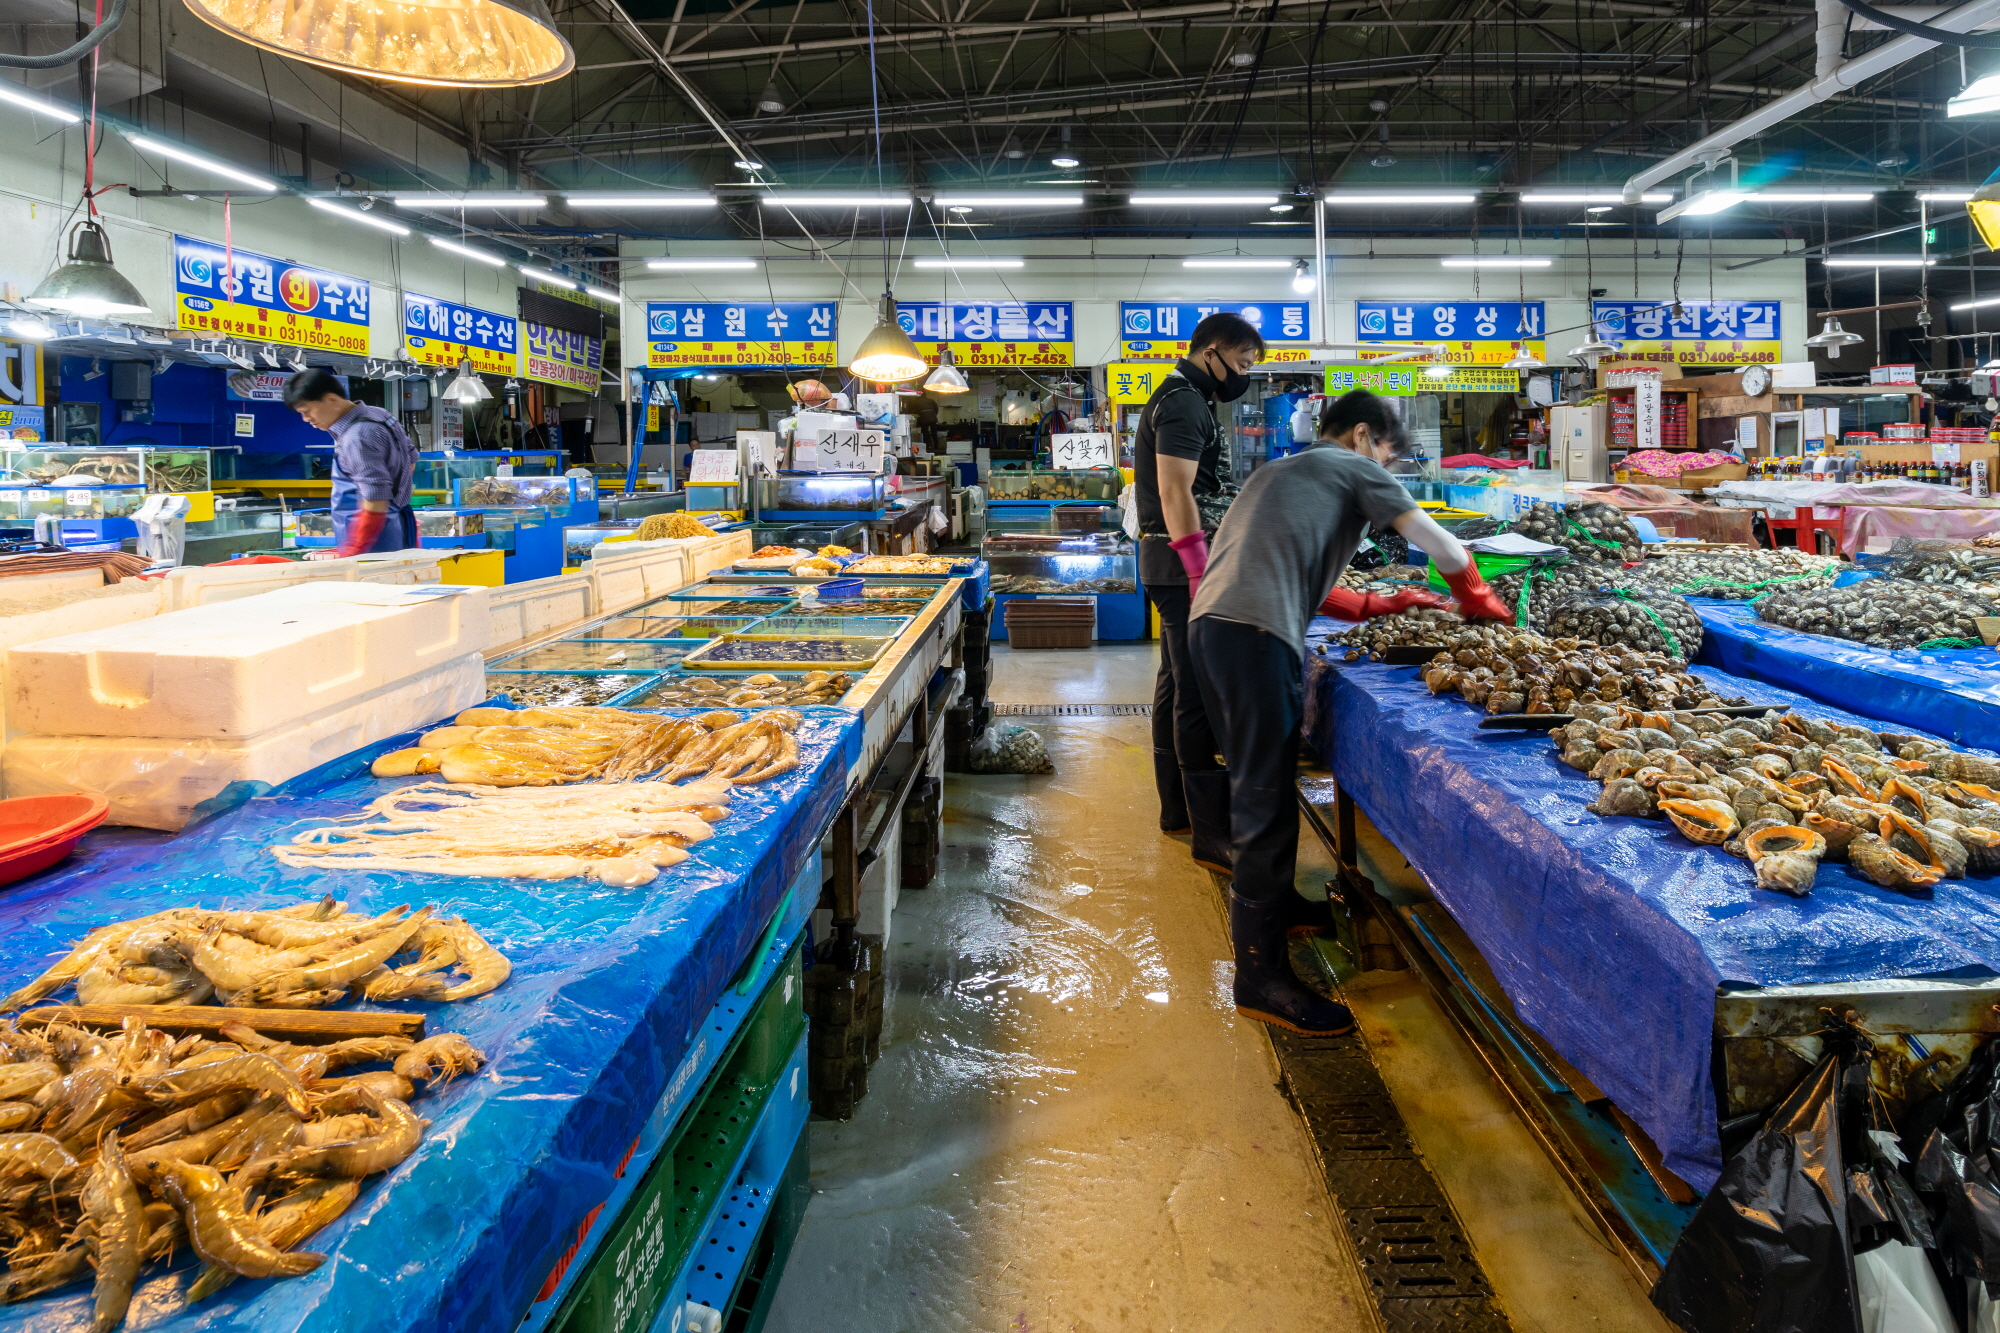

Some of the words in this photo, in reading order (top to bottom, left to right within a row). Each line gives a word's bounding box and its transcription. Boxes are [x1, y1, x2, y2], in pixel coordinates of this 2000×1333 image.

[188, 299, 210, 311] 제156호
[218, 261, 273, 303] 강원
[288, 272, 310, 307] 회
[323, 278, 368, 321] 수산
[428, 305, 514, 349] 해양수산
[681, 307, 831, 337] 삼원수산
[922, 307, 1069, 340] 대성물산
[1392, 306, 1540, 337] 남양상사
[1631, 306, 1776, 338] 광천젓갈
[279, 326, 366, 351] 031)502-0808
[526, 322, 602, 370] 안산민물
[737, 352, 834, 364] 031)409-1645
[971, 353, 1067, 365] 031)417-5452
[1481, 352, 1539, 361] 417-45
[1679, 351, 1775, 363] 031)406-5486
[256, 375, 286, 387] 전어
[528, 356, 599, 389] 민물장어/미꾸라지
[1116, 372, 1152, 395] 꽃게
[819, 431, 881, 457] 산새우
[1058, 438, 1108, 461] 산꽃게
[1975, 462, 1988, 496] 간장게장
[613, 1241, 665, 1333] 1600-5599
